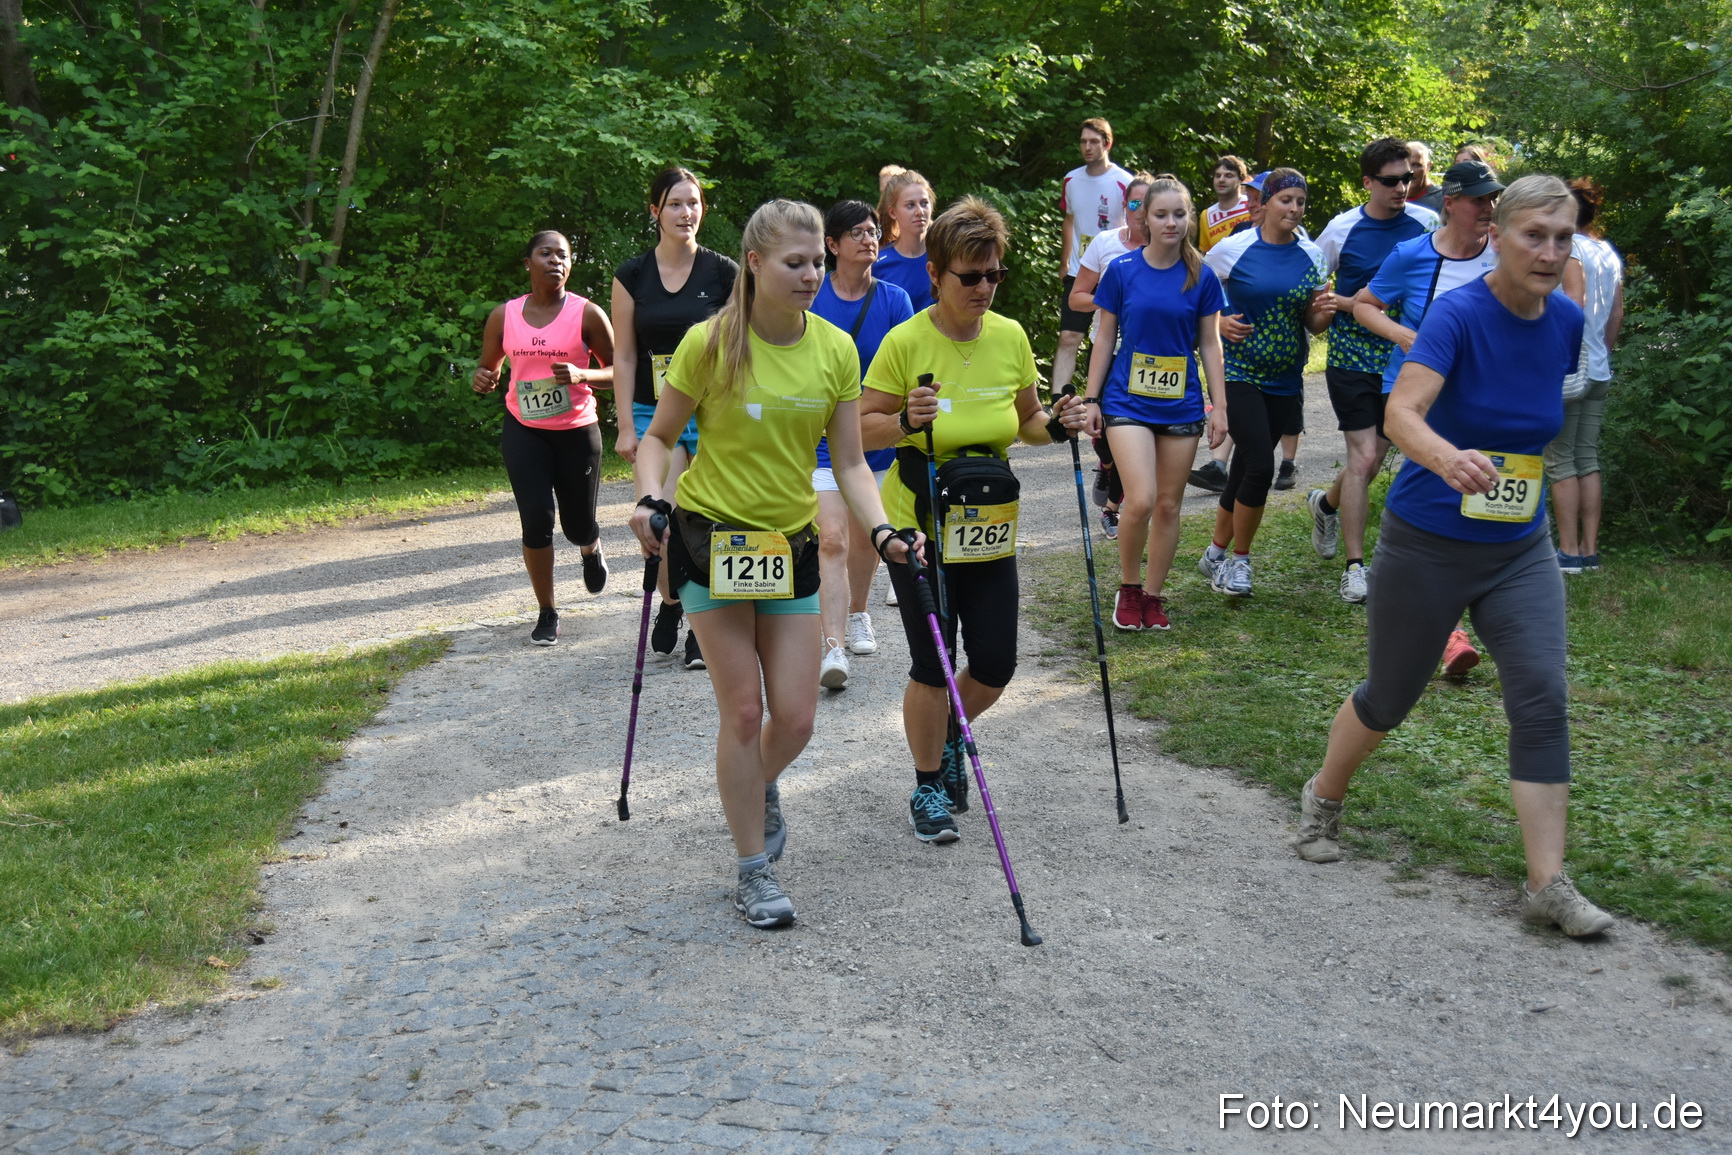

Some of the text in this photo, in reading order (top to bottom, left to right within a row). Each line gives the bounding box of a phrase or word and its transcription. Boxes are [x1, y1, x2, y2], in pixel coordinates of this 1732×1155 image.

[1209, 225, 1227, 238] MAX
[532, 337, 546, 346] Die
[1138, 369, 1179, 387] 1140
[523, 389, 563, 410] 1120
[1484, 478, 1528, 504] 859
[955, 523, 1010, 546] 1262
[722, 556, 784, 580] 1218
